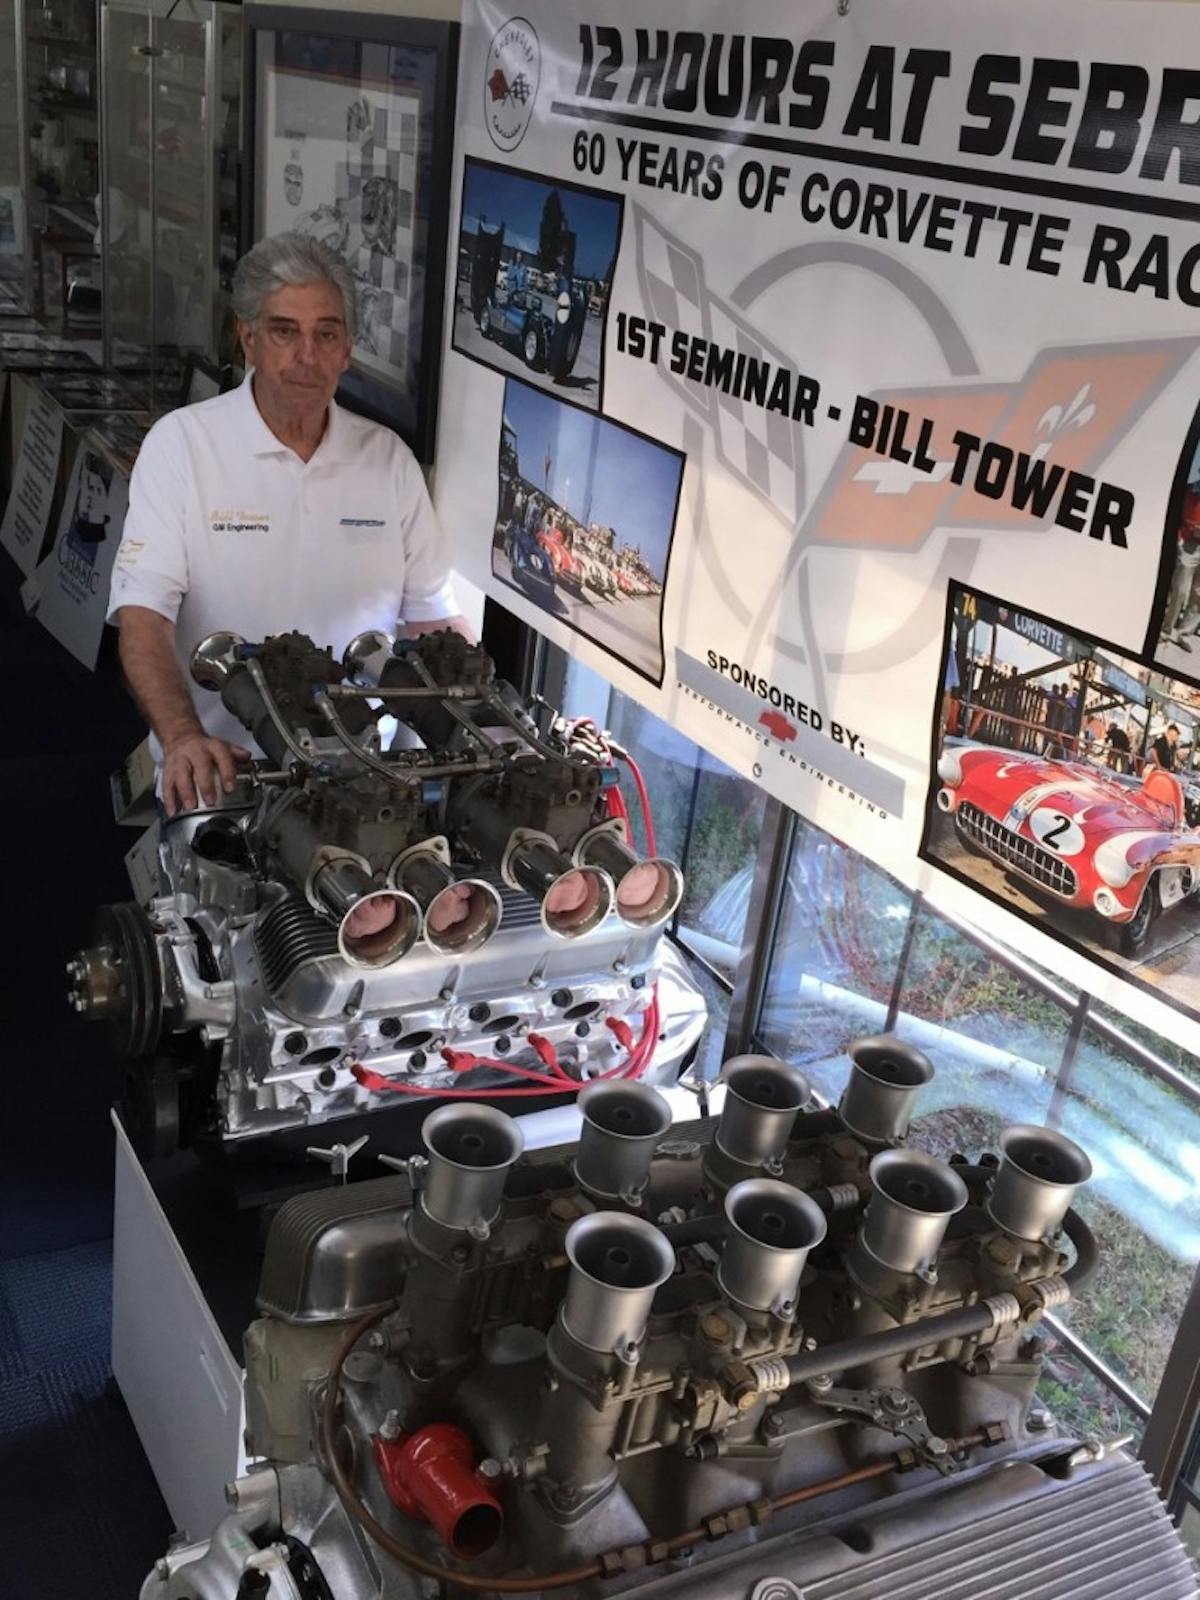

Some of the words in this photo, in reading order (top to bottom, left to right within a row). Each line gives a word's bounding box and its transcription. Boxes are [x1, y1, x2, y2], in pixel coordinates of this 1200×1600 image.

[575, 24, 624, 101] 12
[627, 28, 836, 130] HOURS
[841, 45, 951, 146] AT
[573, 130, 606, 176] 60
[616, 136, 725, 201] YEARS
[738, 161, 791, 213] OF
[801, 173, 1070, 276] CORVETTE
[616, 312, 666, 365] 1ST
[670, 330, 820, 427] SEMINAR
[828, 405, 841, 421] -
[848, 395, 936, 474] BILL
[950, 430, 1136, 549] TOWER
[963, 592, 977, 620] 74
[1014, 613, 1064, 652] CORVETTE
[677, 682, 771, 747] PERFORMANCE
[779, 749, 888, 820] ENGINEERING
[707, 649, 824, 732] SPONSORED
[831, 720, 865, 758] BY:
[1042, 815, 1071, 850] 2
